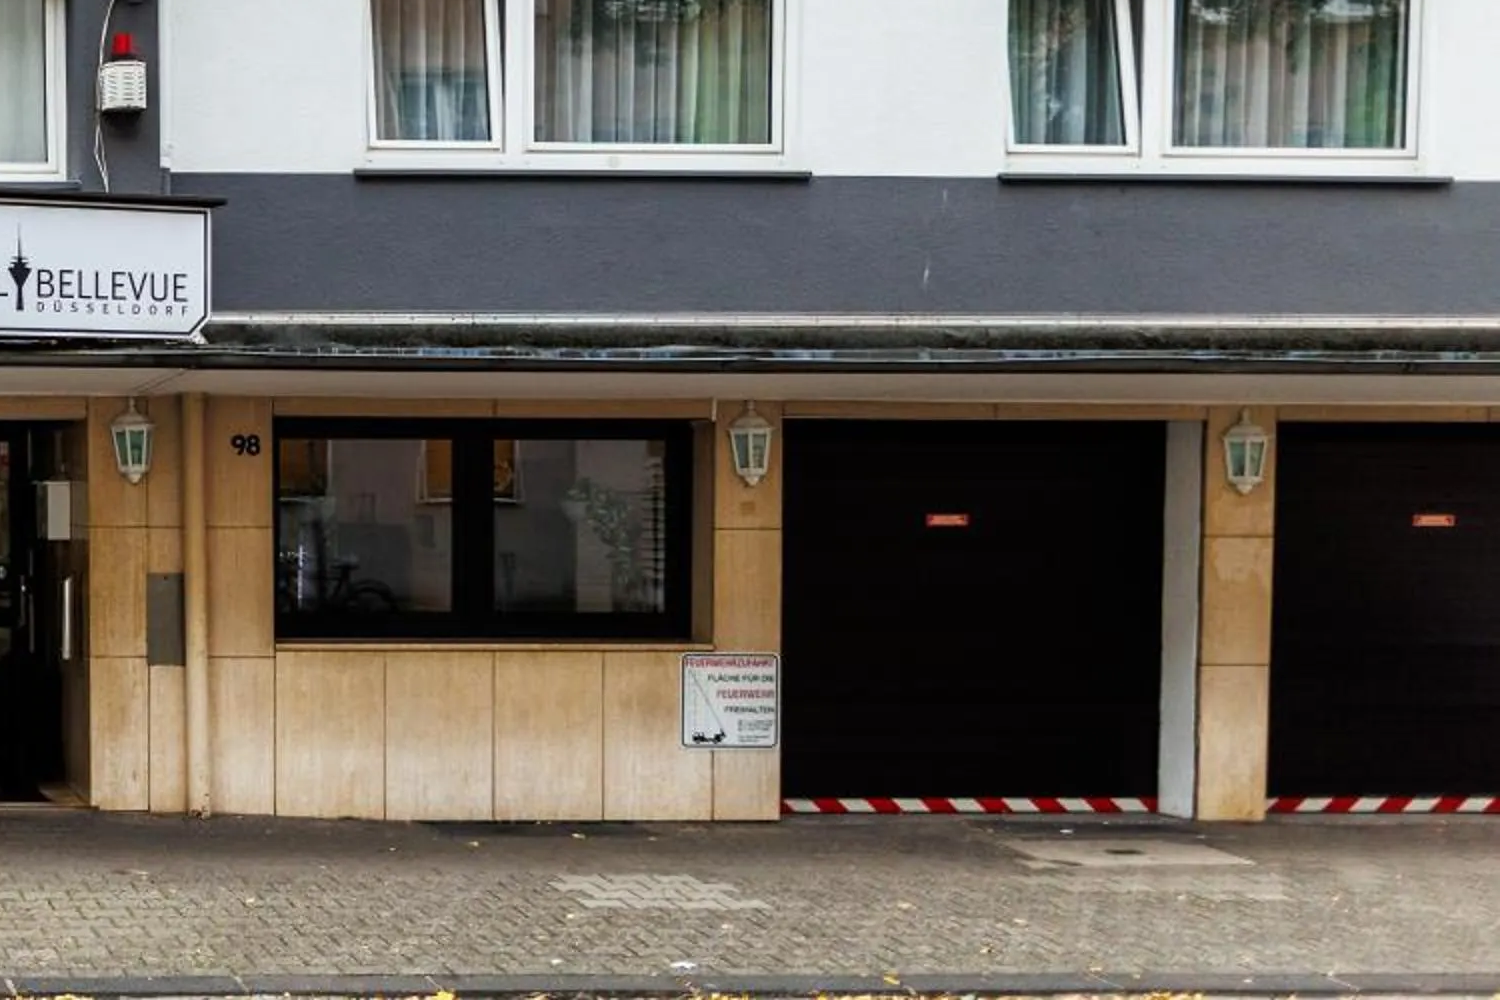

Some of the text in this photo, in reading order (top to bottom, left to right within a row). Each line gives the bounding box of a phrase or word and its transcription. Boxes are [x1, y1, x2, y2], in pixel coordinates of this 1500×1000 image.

[36, 268, 189, 303] BELLEVUE
[36, 300, 189, 317] DÜSSELDORF
[231, 434, 260, 456] 98
